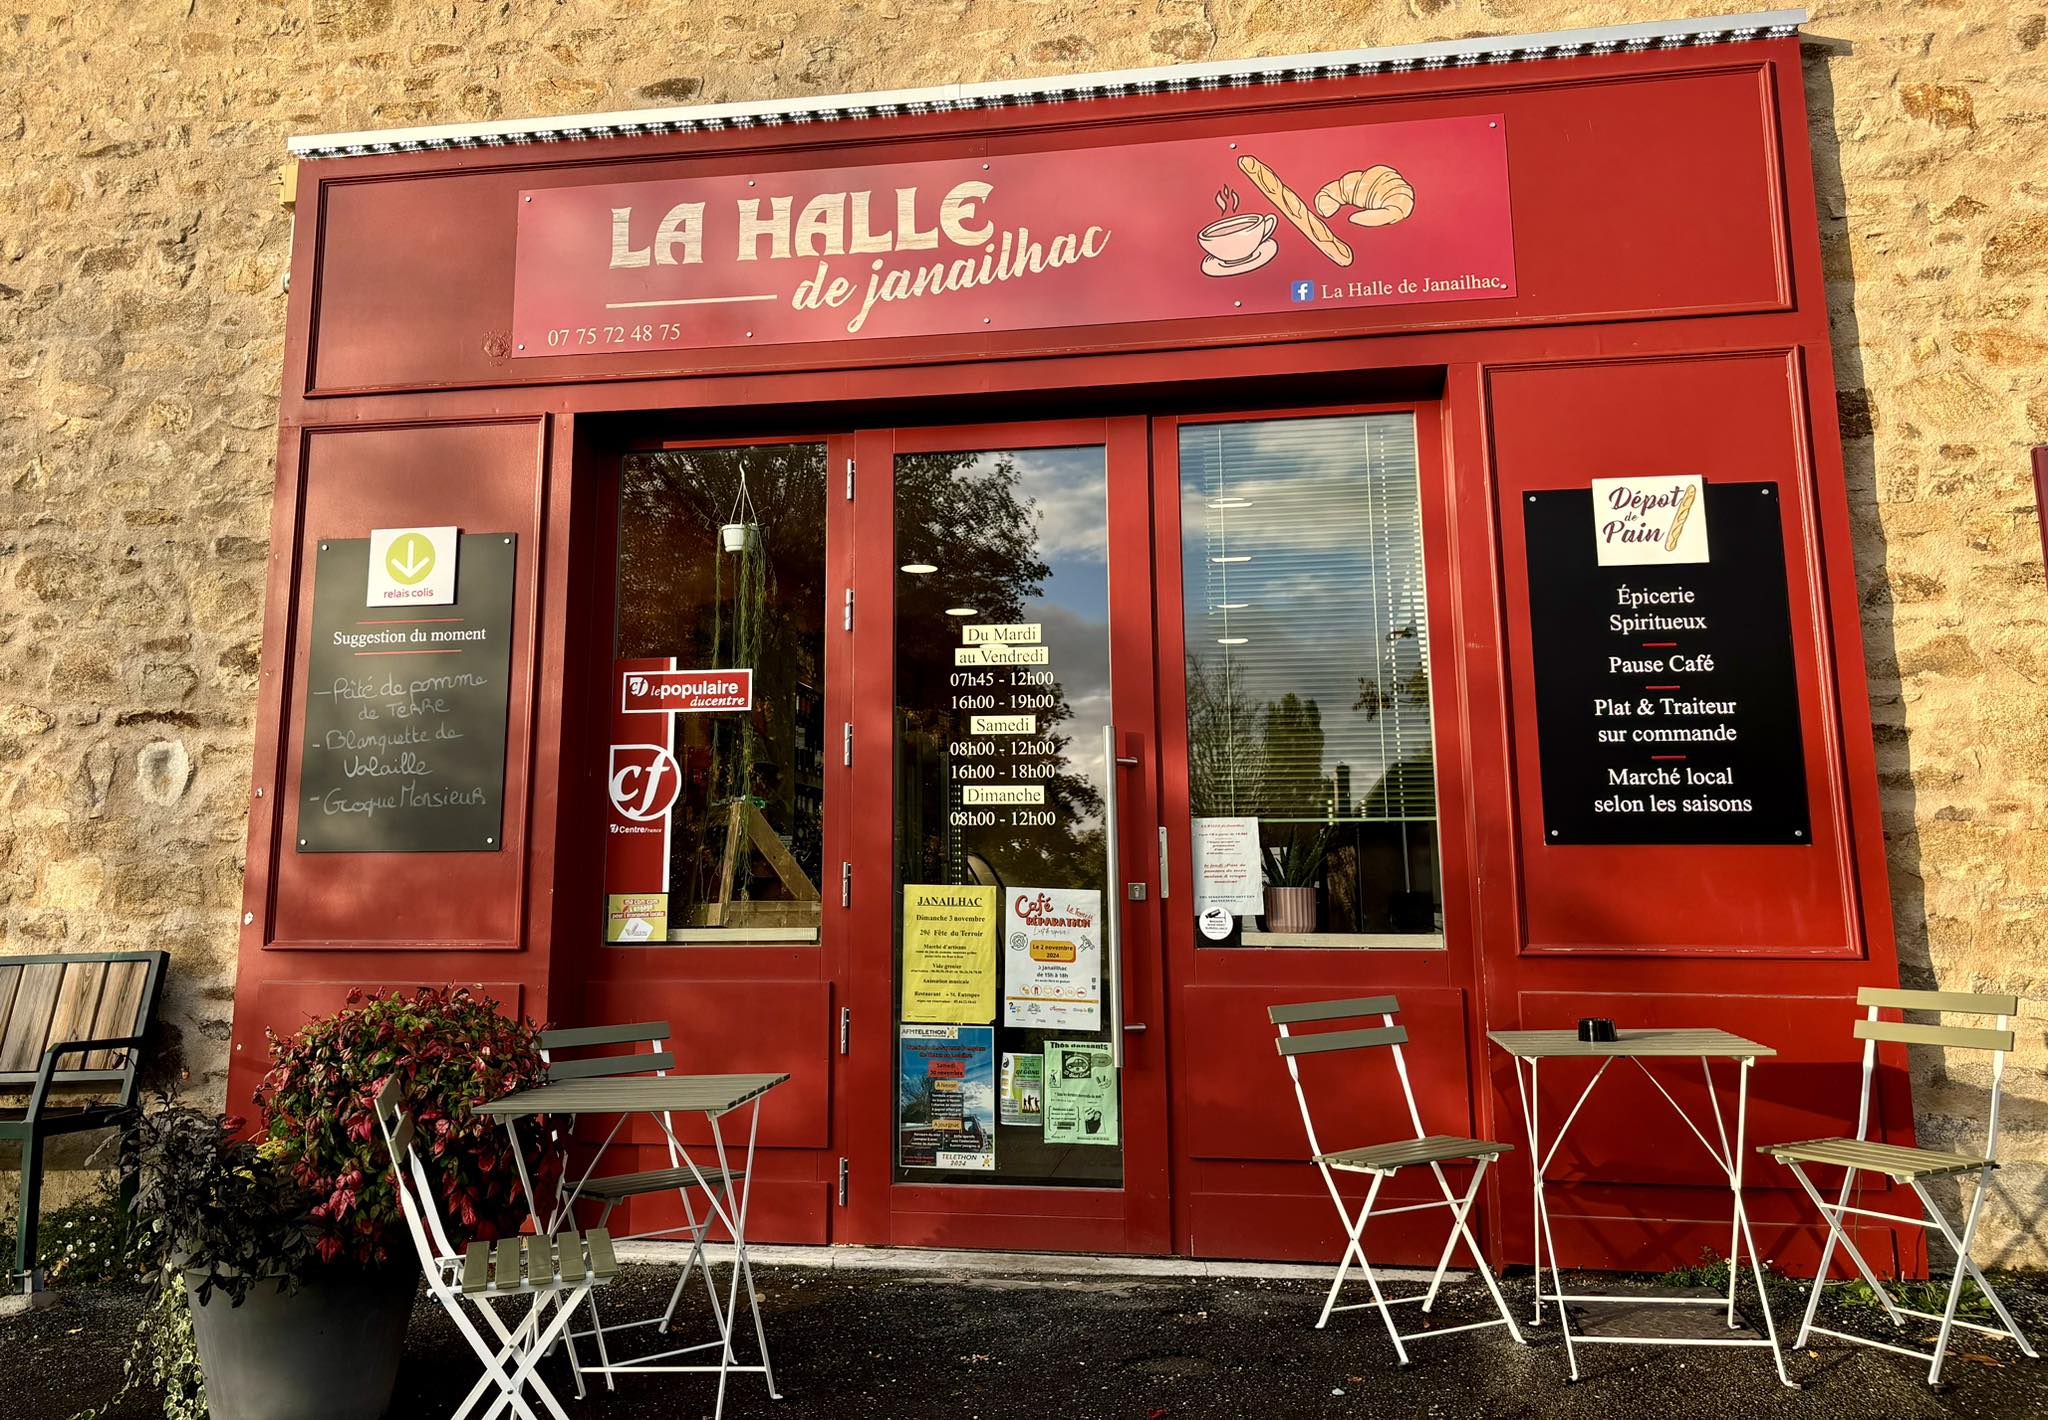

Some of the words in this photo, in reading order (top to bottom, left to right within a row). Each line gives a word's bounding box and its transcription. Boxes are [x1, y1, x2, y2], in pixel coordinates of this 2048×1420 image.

[609, 201, 706, 269] LA
[736, 181, 994, 261] HALLE
[792, 260, 855, 311] de
[847, 224, 1112, 333] janailhac
[1321, 284, 1343, 299] La
[1349, 280, 1393, 297] Halle
[1397, 279, 1418, 295] de
[1422, 274, 1500, 293] Janailhac
[547, 326, 572, 347] 07
[576, 325, 597, 345] 75
[603, 323, 625, 343] 72
[628, 321, 653, 342] 48
[657, 320, 681, 340] 75
[1608, 484, 1685, 516] Dépot
[1624, 511, 1638, 522] de
[1603, 520, 1665, 544] Pain
[383, 588, 410, 599] relais
[411, 587, 434, 598] colis
[1617, 584, 1695, 608] Épicerie
[1609, 613, 1707, 635] Spiritueux
[333, 630, 406, 648] Suggestion
[409, 629, 428, 643] du
[431, 628, 486, 642] moment
[968, 628, 989, 641] Du
[994, 627, 1036, 641] Mardi
[959, 653, 975, 664] au
[981, 649, 1043, 663] Vendredi
[1609, 656, 1664, 674] Pause
[1668, 654, 1715, 672] Café
[950, 673, 994, 686] 07h45
[1010, 672, 1054, 685] 12h00
[334, 676, 377, 704] Pâté
[380, 677, 407, 696] de
[409, 673, 488, 703] pomme
[690, 696, 745, 706] ducentre
[951, 695, 994, 709] 16h00
[1010, 694, 1054, 708] 19h00
[1594, 698, 1632, 716] Plat
[1636, 698, 1655, 715] &
[1660, 697, 1737, 715] Traiteur
[358, 703, 380, 720] de
[976, 718, 1029, 732] Samedi
[1598, 728, 1627, 743] sur
[1632, 724, 1737, 742] commande
[326, 729, 426, 756] Blanquette
[428, 727, 464, 741] de
[950, 742, 995, 755] 08h00
[1011, 741, 1055, 755] 12h00
[343, 753, 433, 778] Volaille
[951, 765, 995, 779] 16h00
[1011, 764, 1055, 778] 18h00
[609, 751, 670, 818] cf
[1608, 767, 1681, 786] Marché
[1686, 767, 1734, 785] local
[967, 788, 1041, 802] Dimanche
[1594, 796, 1644, 813] selon
[1650, 795, 1677, 812] les
[1682, 795, 1752, 812] saisons
[950, 811, 995, 826] 08h00
[1011, 811, 1056, 825] 12h00
[917, 897, 983, 907] JANAILHAC
[1015, 892, 1054, 918] Café
[916, 914, 948, 922] Dimanche
[1026, 915, 1091, 928] RÉPARATION
[934, 929, 948, 937] Fête
